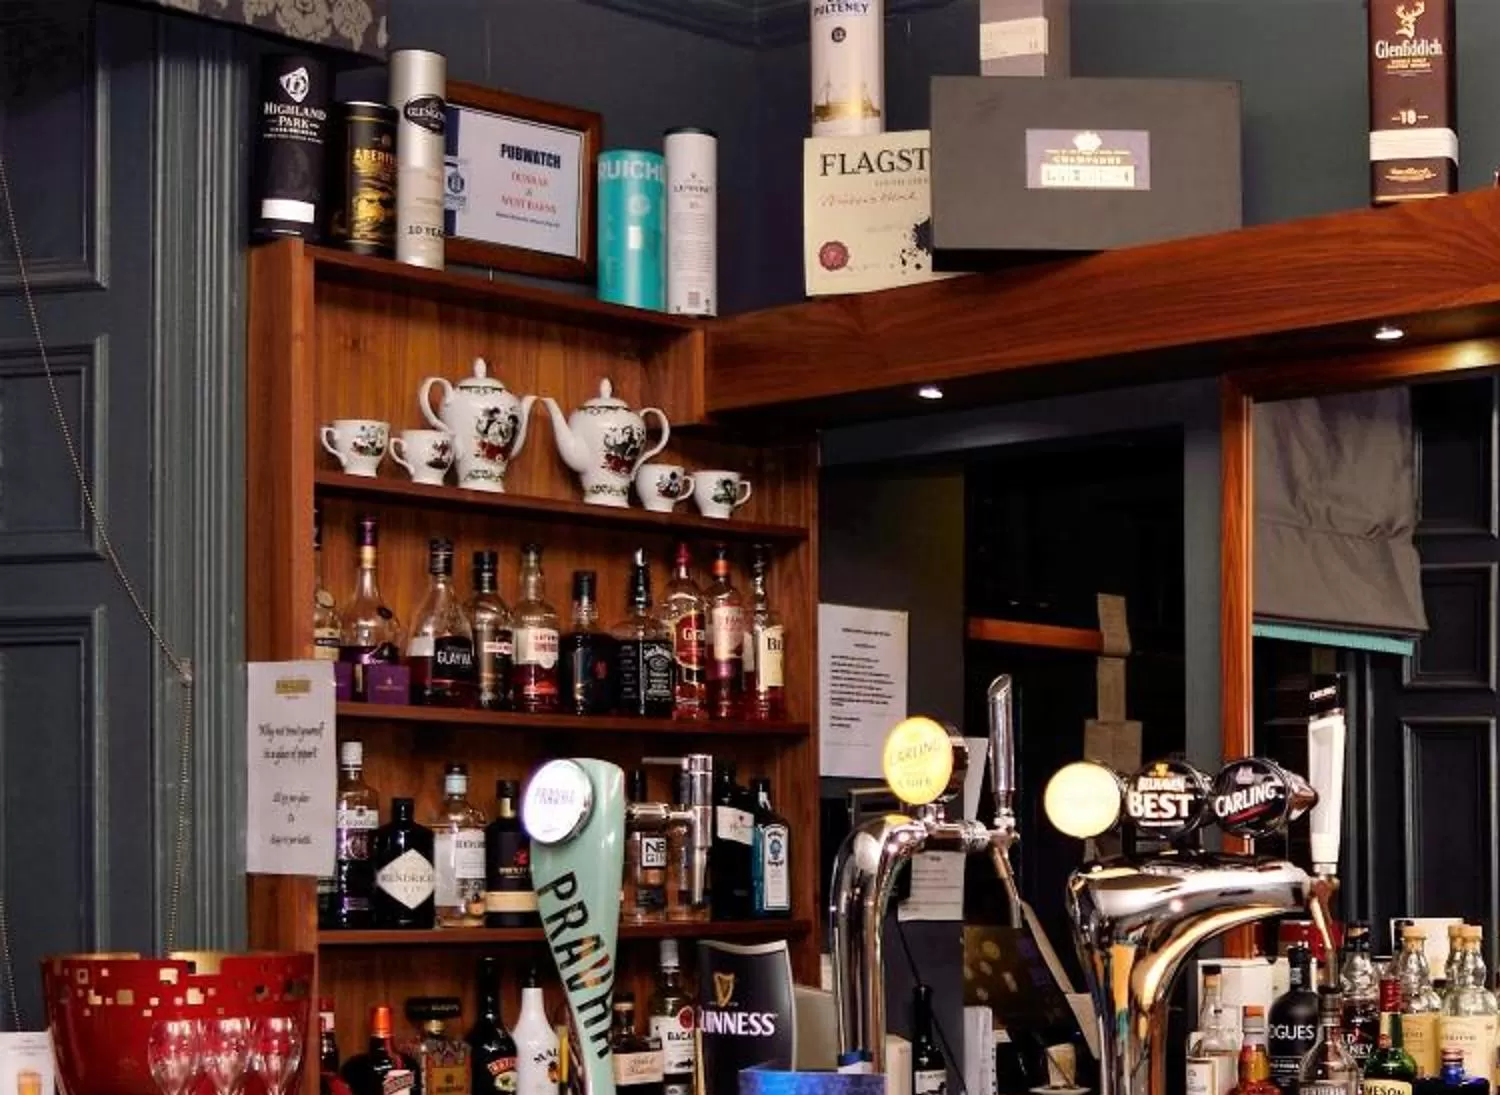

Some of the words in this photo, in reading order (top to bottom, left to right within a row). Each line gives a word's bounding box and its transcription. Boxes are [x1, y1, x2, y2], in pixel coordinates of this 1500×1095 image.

[1375, 38, 1443, 59] Glenfiddich
[263, 101, 327, 120] HIGHLAND
[278, 115, 310, 129] PARK
[500, 143, 561, 169] PUBWATCH
[1129, 792, 1194, 819] BEST
[1215, 781, 1277, 818] CARLING
[536, 871, 615, 1060] PRAVHA
